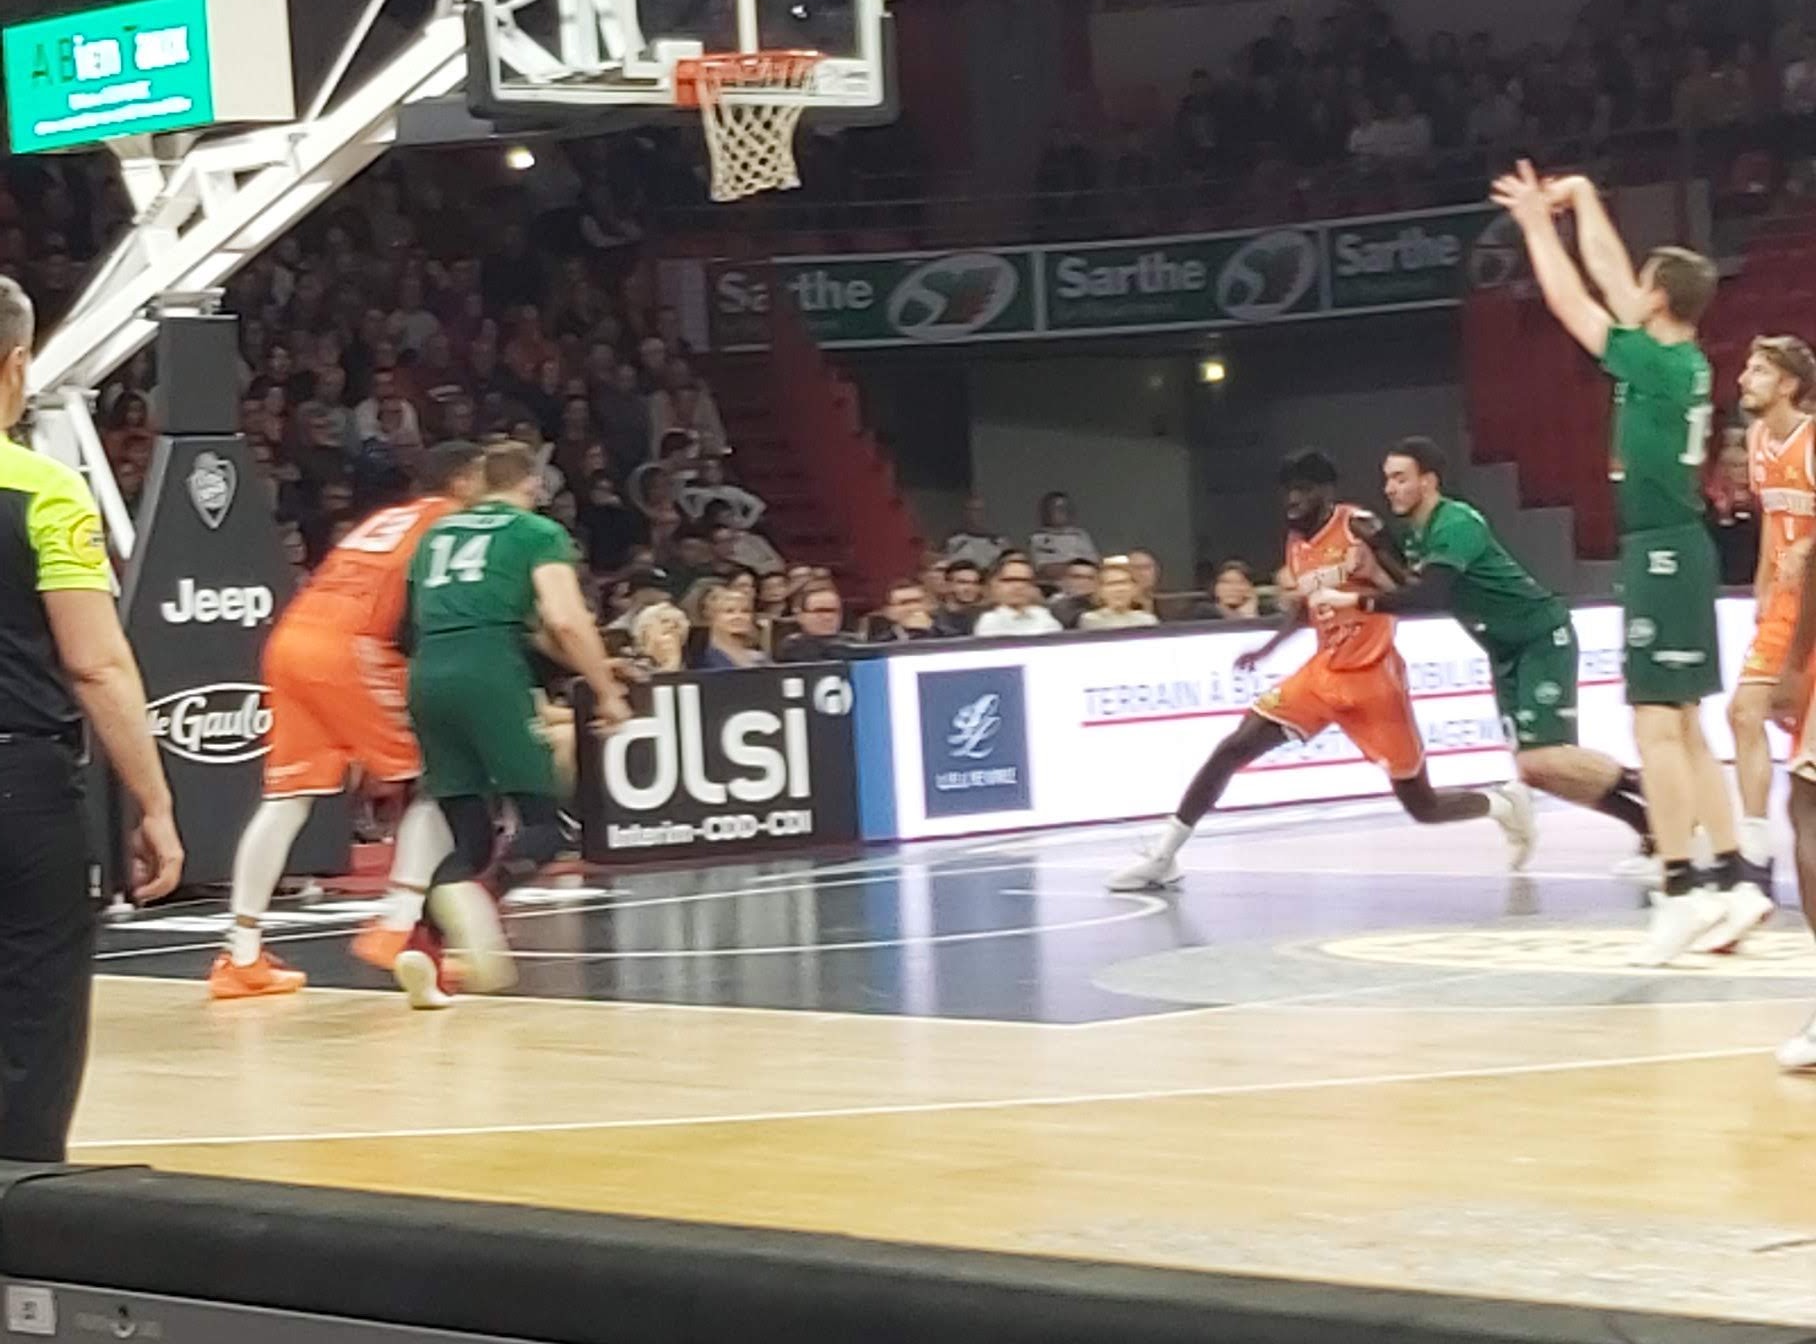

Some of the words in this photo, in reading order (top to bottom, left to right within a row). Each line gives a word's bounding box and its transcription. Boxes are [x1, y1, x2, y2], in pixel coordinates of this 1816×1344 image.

[1056, 252, 1207, 299] Sarthe
[1335, 226, 1461, 277] Sarthe
[423, 534, 493, 588] 14
[161, 578, 274, 627] Jeep
[170, 692, 274, 752] Gaulo
[603, 677, 812, 810] dlsi
